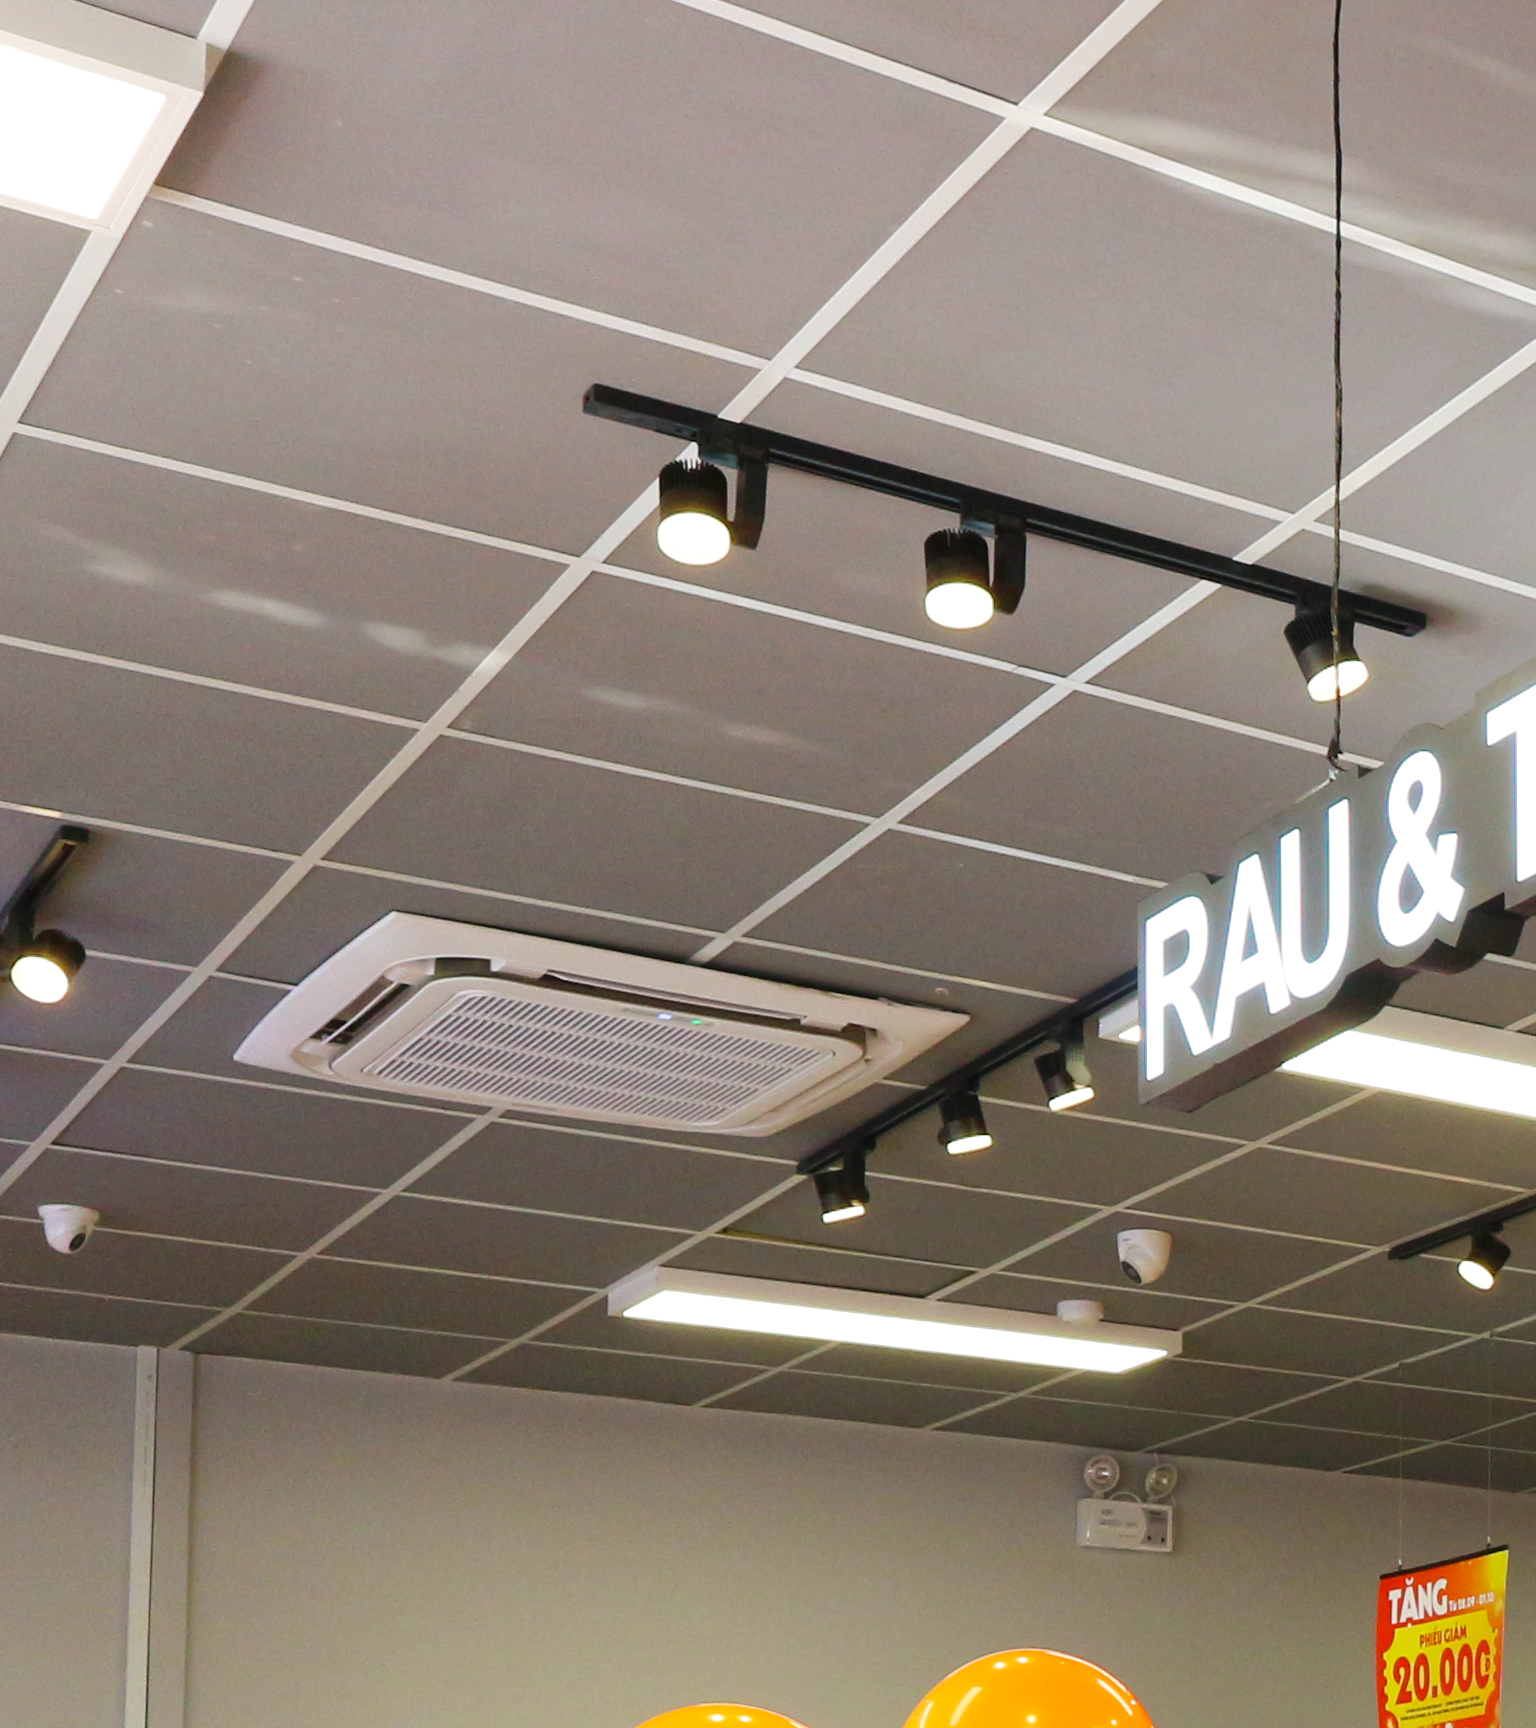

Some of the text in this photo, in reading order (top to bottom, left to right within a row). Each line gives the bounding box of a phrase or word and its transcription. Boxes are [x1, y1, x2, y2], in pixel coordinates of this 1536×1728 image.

[1145, 799, 1349, 1080] RAU
[1378, 750, 1464, 947] &
[1389, 1577, 1448, 1628] TẶNG
